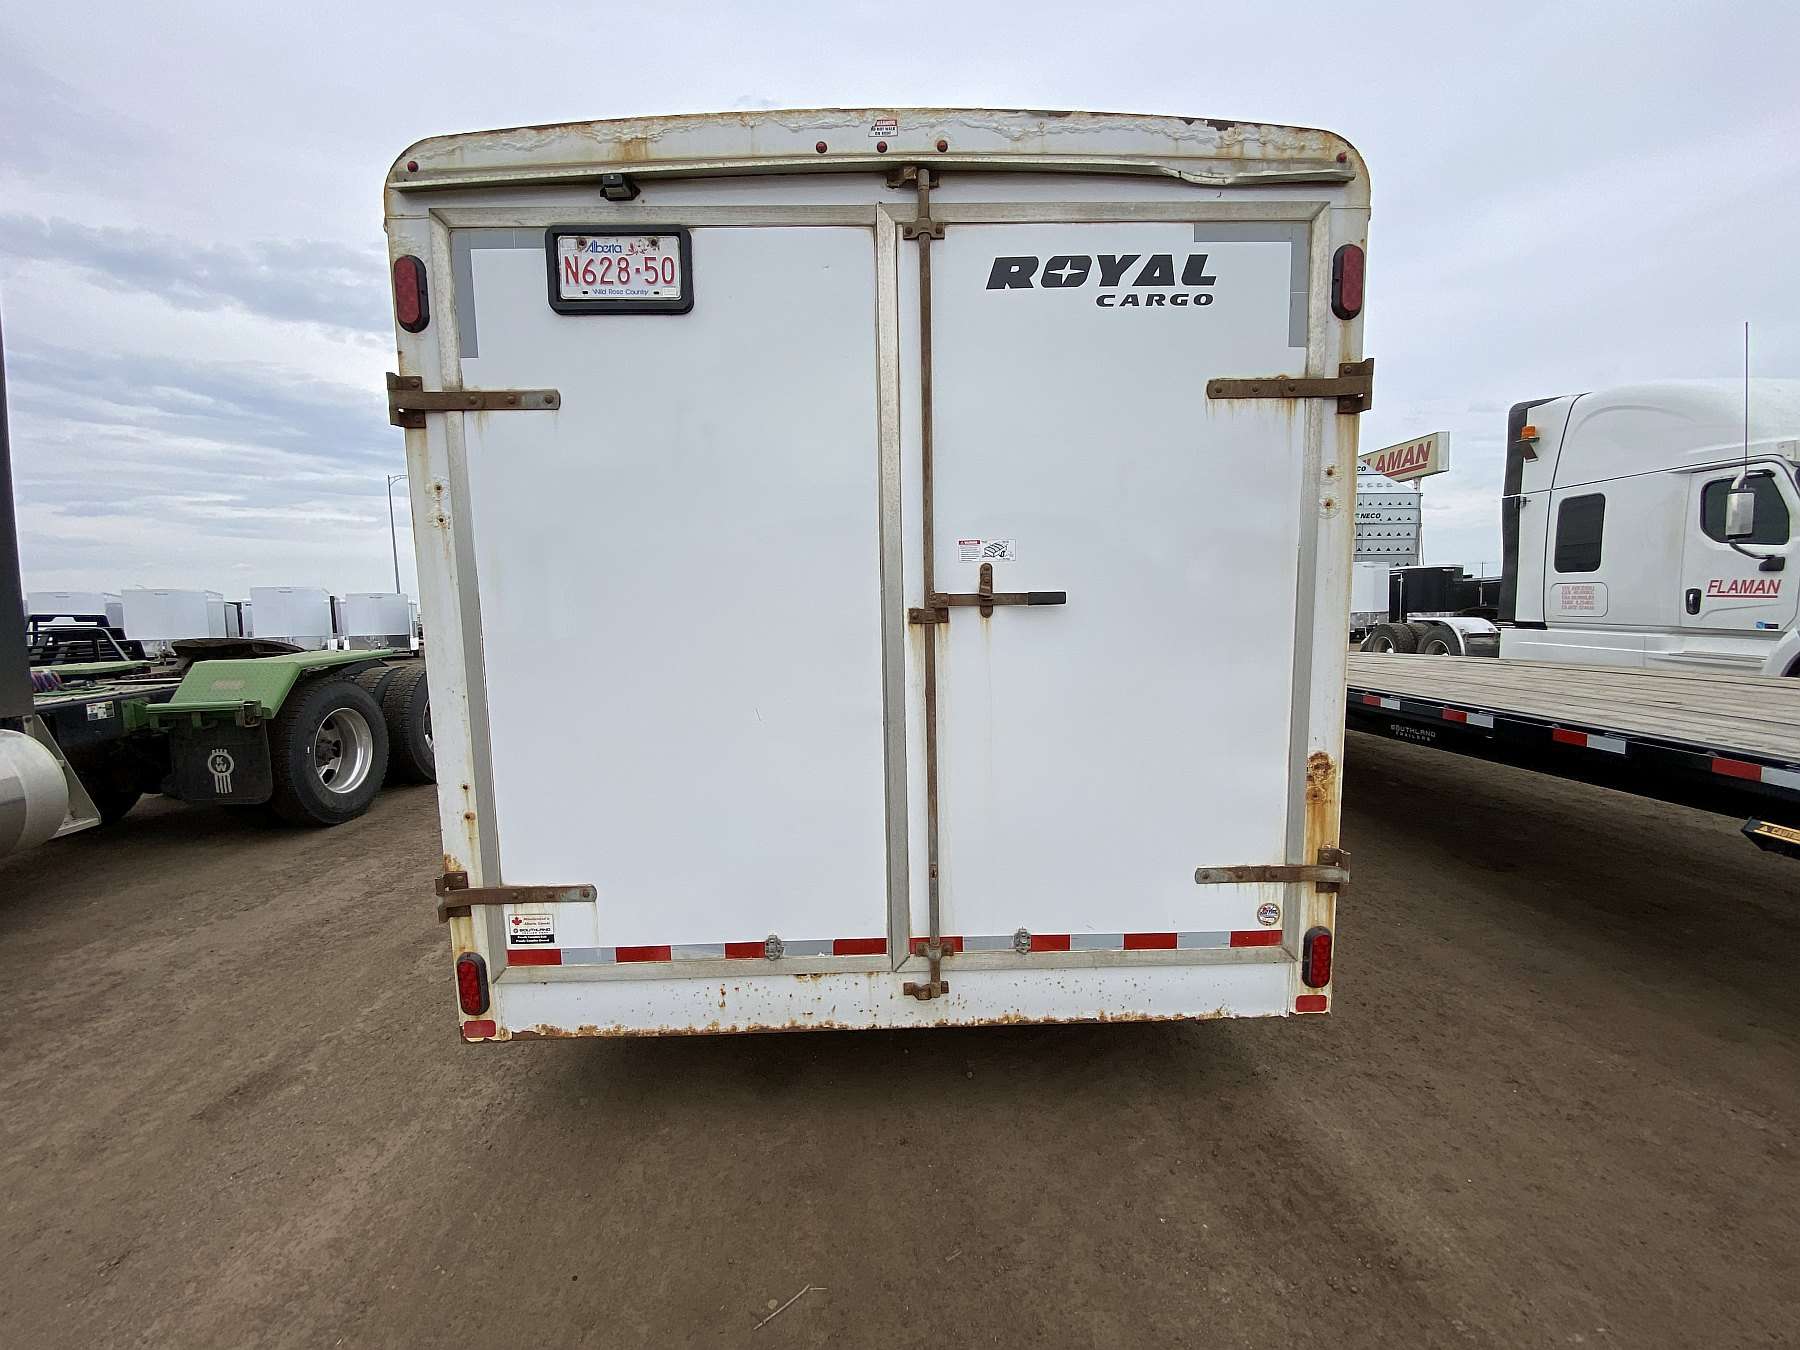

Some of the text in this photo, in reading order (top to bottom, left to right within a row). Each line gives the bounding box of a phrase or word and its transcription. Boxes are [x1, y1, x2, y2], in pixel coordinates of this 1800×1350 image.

[585, 240, 623, 254] Alberta
[986, 254, 1217, 290] ROYAL
[592, 288, 649, 297] Wild Rose County
[1096, 293, 1214, 308] CARGO
[1707, 579, 1782, 594] FLAMAN
